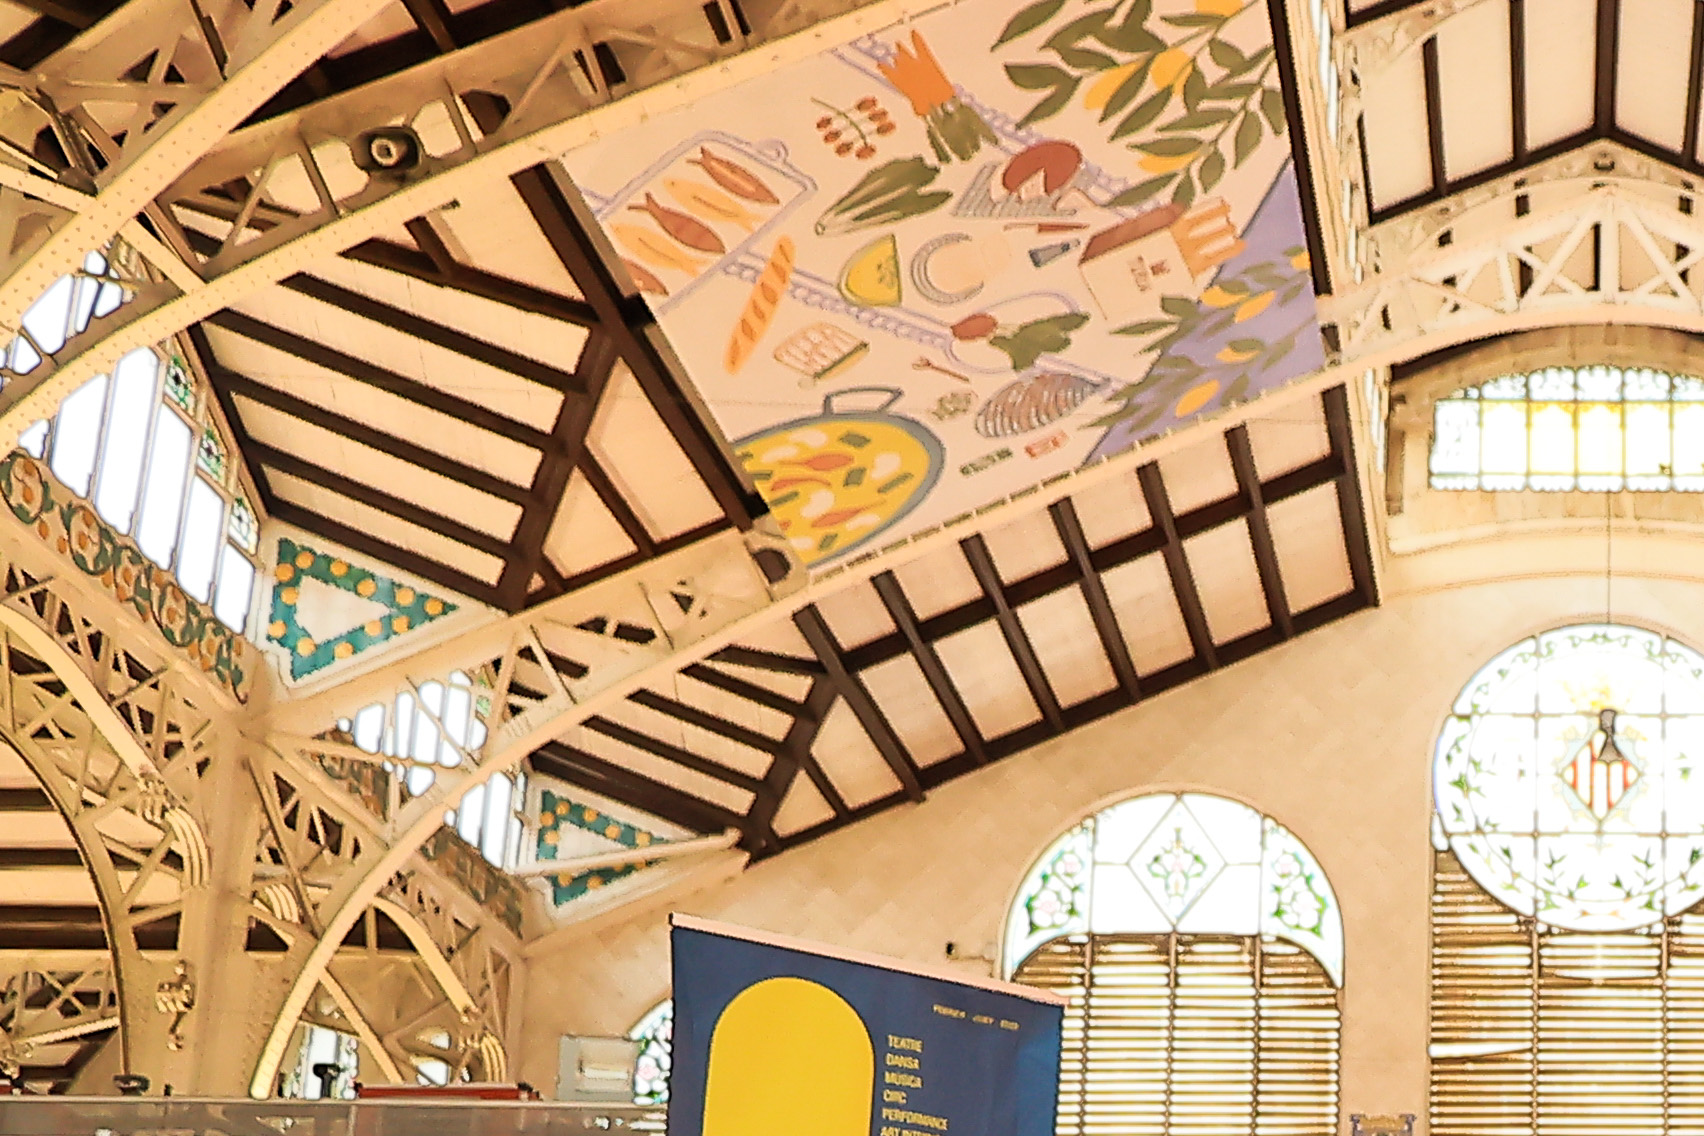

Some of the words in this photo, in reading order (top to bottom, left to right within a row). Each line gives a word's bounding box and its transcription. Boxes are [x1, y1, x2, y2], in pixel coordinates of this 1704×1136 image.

[888, 1034, 923, 1053] TEATRE
[886, 1053, 920, 1070] DANSA
[882, 1107, 949, 1131] PERFORMANCE
